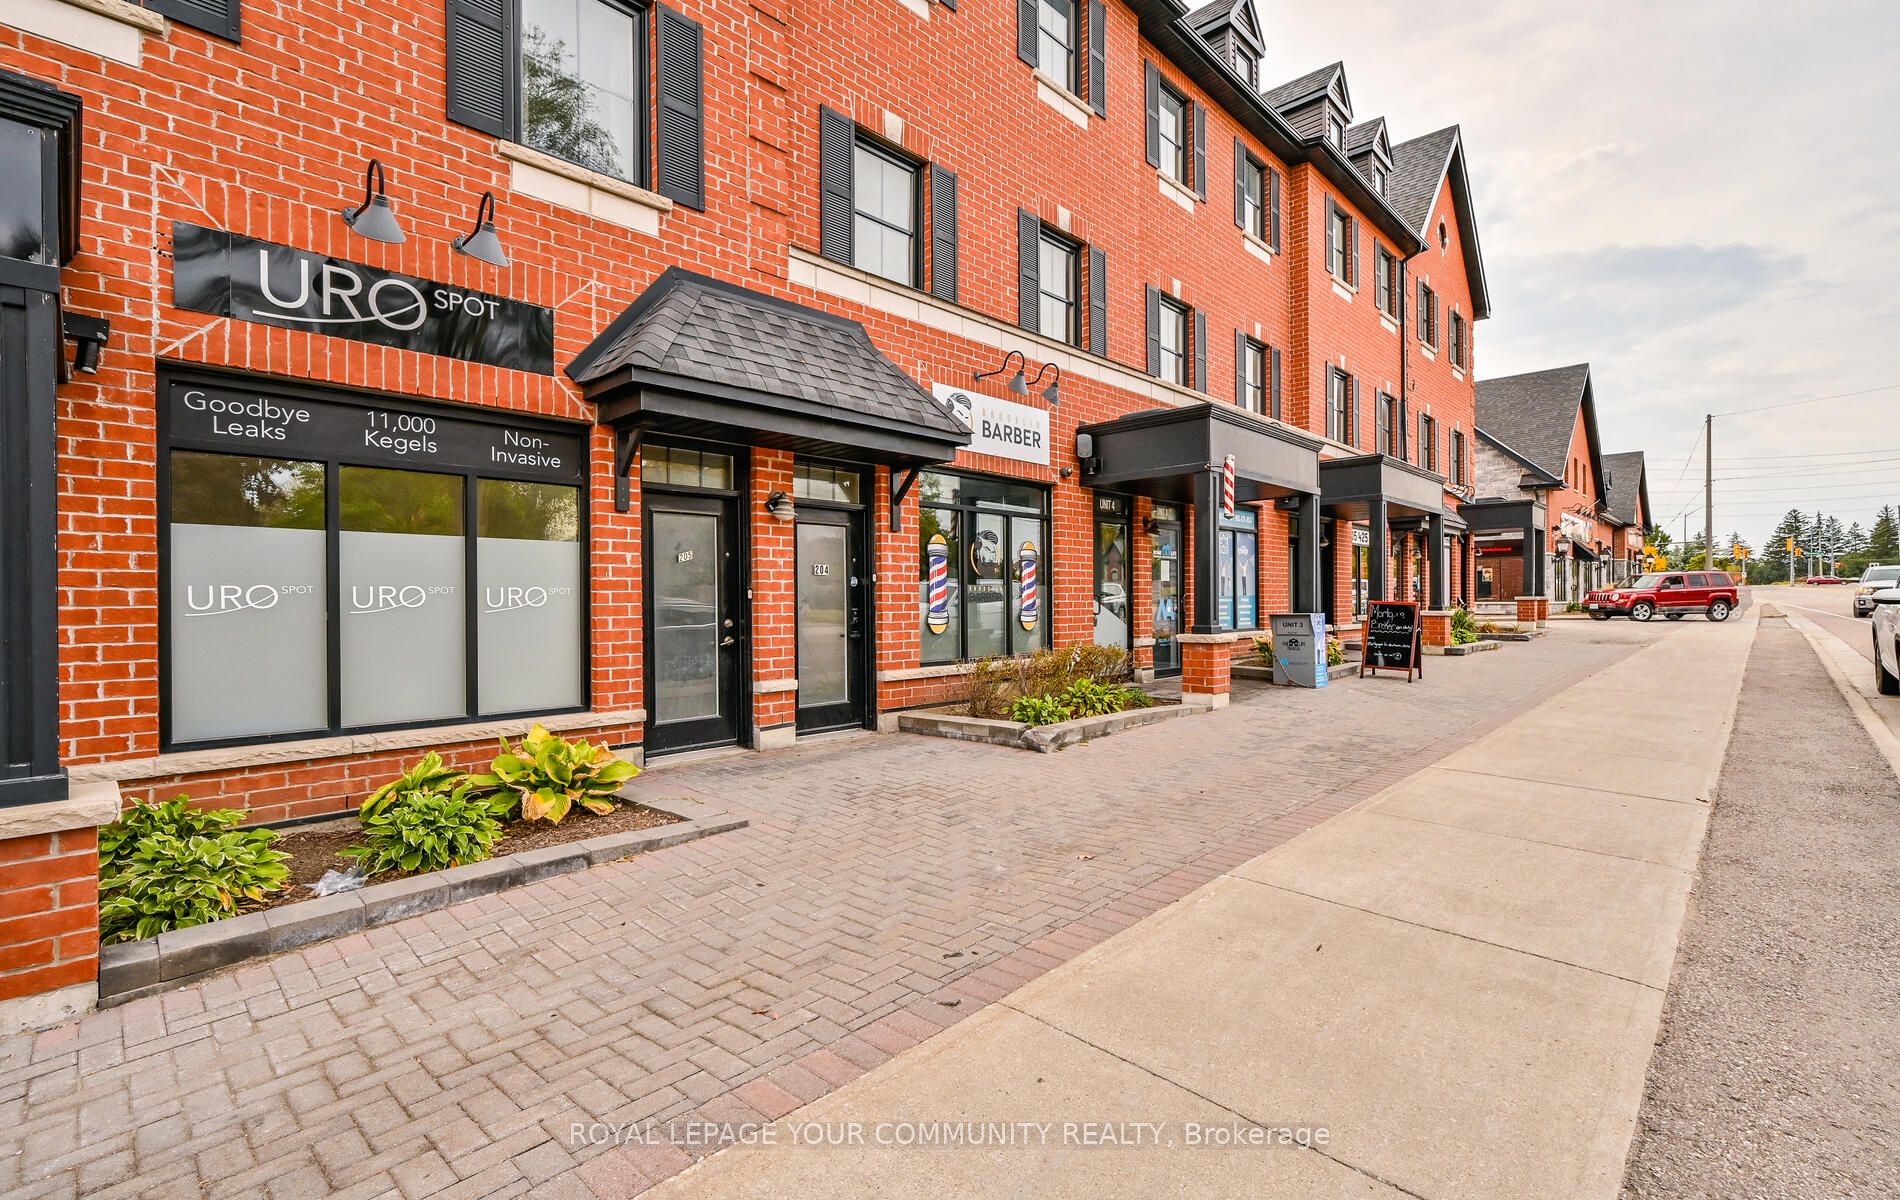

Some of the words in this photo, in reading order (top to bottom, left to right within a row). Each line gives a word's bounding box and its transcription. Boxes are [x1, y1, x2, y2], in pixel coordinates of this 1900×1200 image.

[257, 249, 427, 331] URO
[434, 289, 500, 320] SPOT
[184, 391, 310, 425] Goodbye
[982, 408, 1040, 429] BROOKLIN
[212, 410, 286, 440] Leaks
[367, 410, 436, 434] 11,000
[982, 420, 1041, 448] BARBER
[364, 429, 437, 454] Kegels
[504, 430, 549, 449] Non-
[491, 446, 561, 468] Invasive
[1099, 499, 1111, 510] UNIT
[1111, 500, 1115, 511] 4
[679, 552, 692, 562] 205
[815, 565, 829, 575] 204
[186, 584, 279, 612] URO
[281, 585, 314, 594] SPOT
[351, 585, 426, 609] URO
[428, 586, 455, 595] SPOT
[485, 586, 547, 610] URO
[549, 587, 572, 595] SPOT
